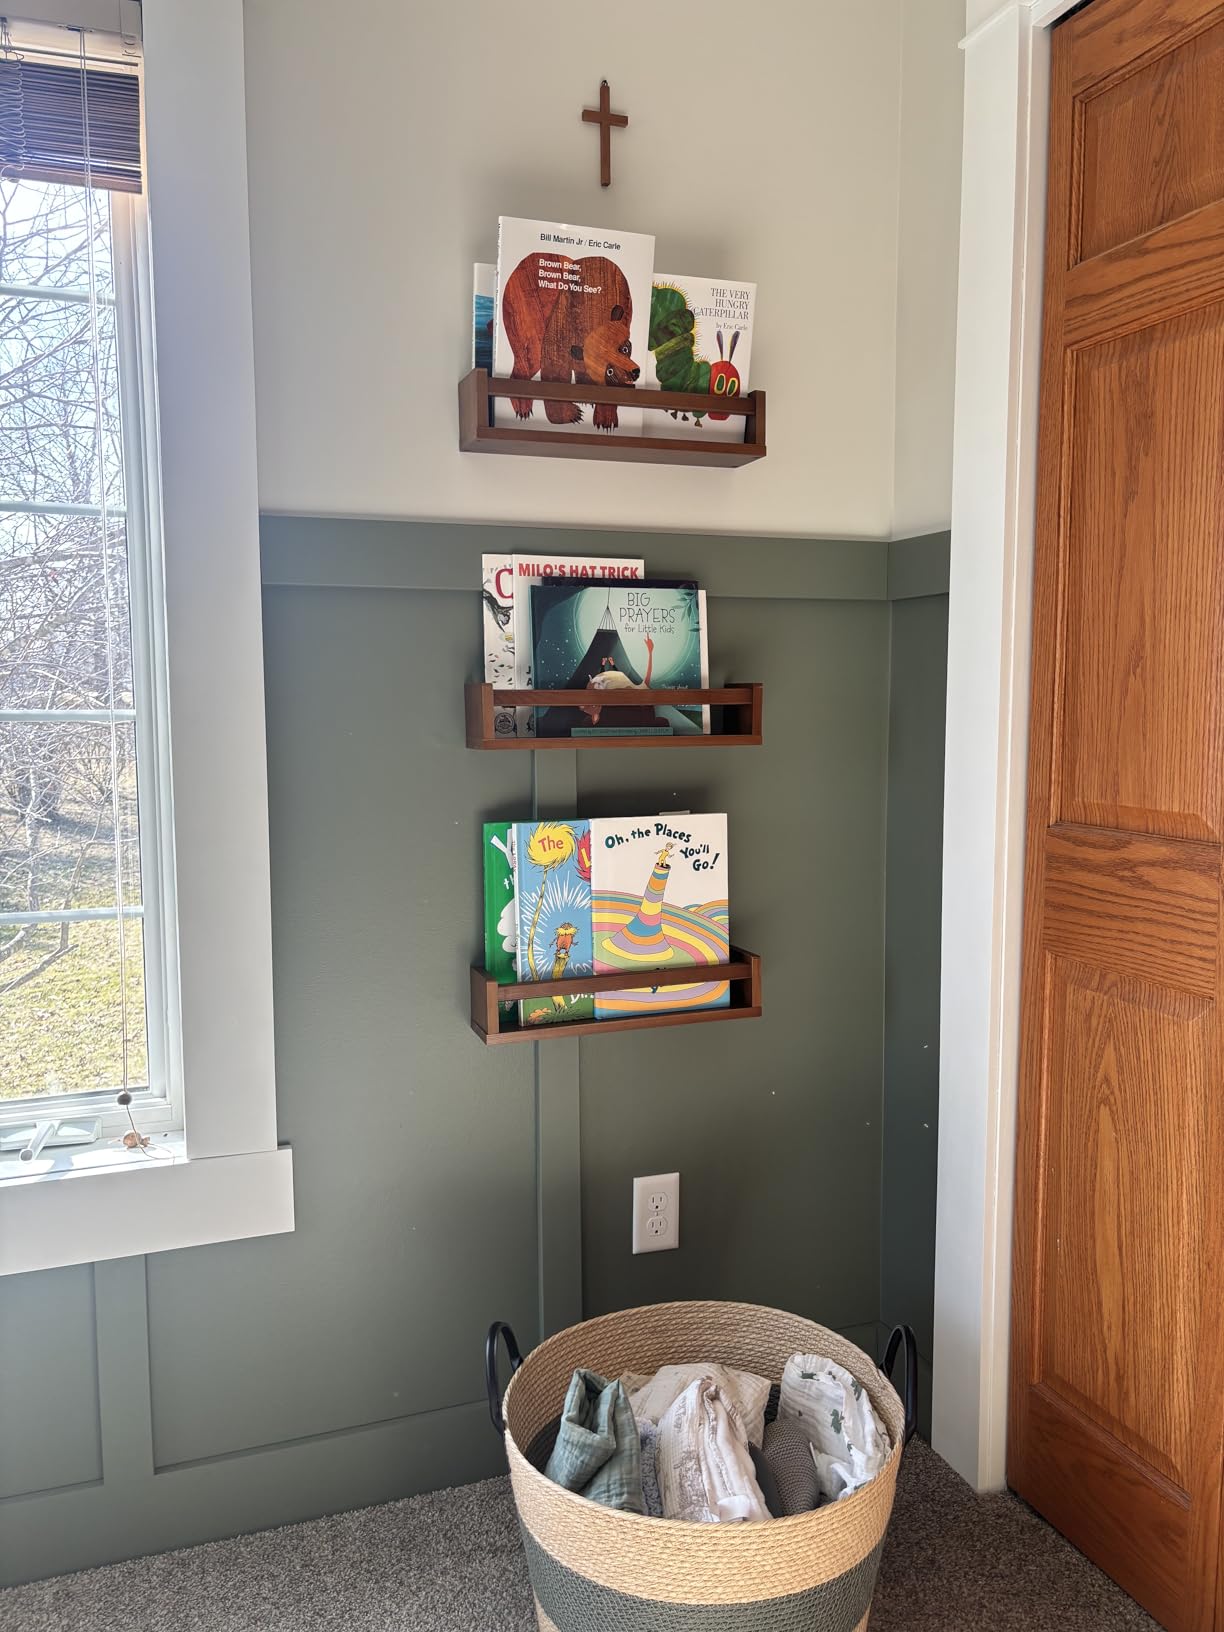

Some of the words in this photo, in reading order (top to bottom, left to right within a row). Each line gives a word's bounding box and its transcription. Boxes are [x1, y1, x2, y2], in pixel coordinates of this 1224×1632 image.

[540, 233, 552, 242] Bill
[552, 235, 575, 245] Martin
[576, 237, 584, 246] Jr
[588, 239, 602, 248] Eric
[602, 241, 621, 251] Carle
[539, 259, 562, 270] Brown
[563, 262, 582, 273] Bear,
[539, 270, 562, 280] Brown
[562, 272, 581, 283] Bear,
[538, 280, 557, 290] What
[558, 282, 569, 291] Do
[569, 283, 582, 293] You
[583, 284, 602, 295] See?
[710, 288, 728, 298] THE
[729, 290, 750, 301] VERY
[715, 298, 750, 310] HUNGRY
[693, 306, 750, 320] CATERPILLAR
[734, 323, 748, 331] Carle
[518, 562, 566, 577] MILO'S
[570, 565, 597, 578] HAT
[600, 566, 640, 580] TRICK
[627, 592, 650, 606] BIG
[620, 608, 676, 624] PRAYERS
[624, 622, 636, 632] for
[638, 624, 657, 634] Little
[660, 624, 675, 634] Kids
[604, 834, 630, 848] Oh,
[631, 828, 652, 840] the
[654, 822, 692, 843] Places
[538, 836, 564, 852] The
[680, 844, 710, 858] You'll
[692, 853, 720, 871] Go!
